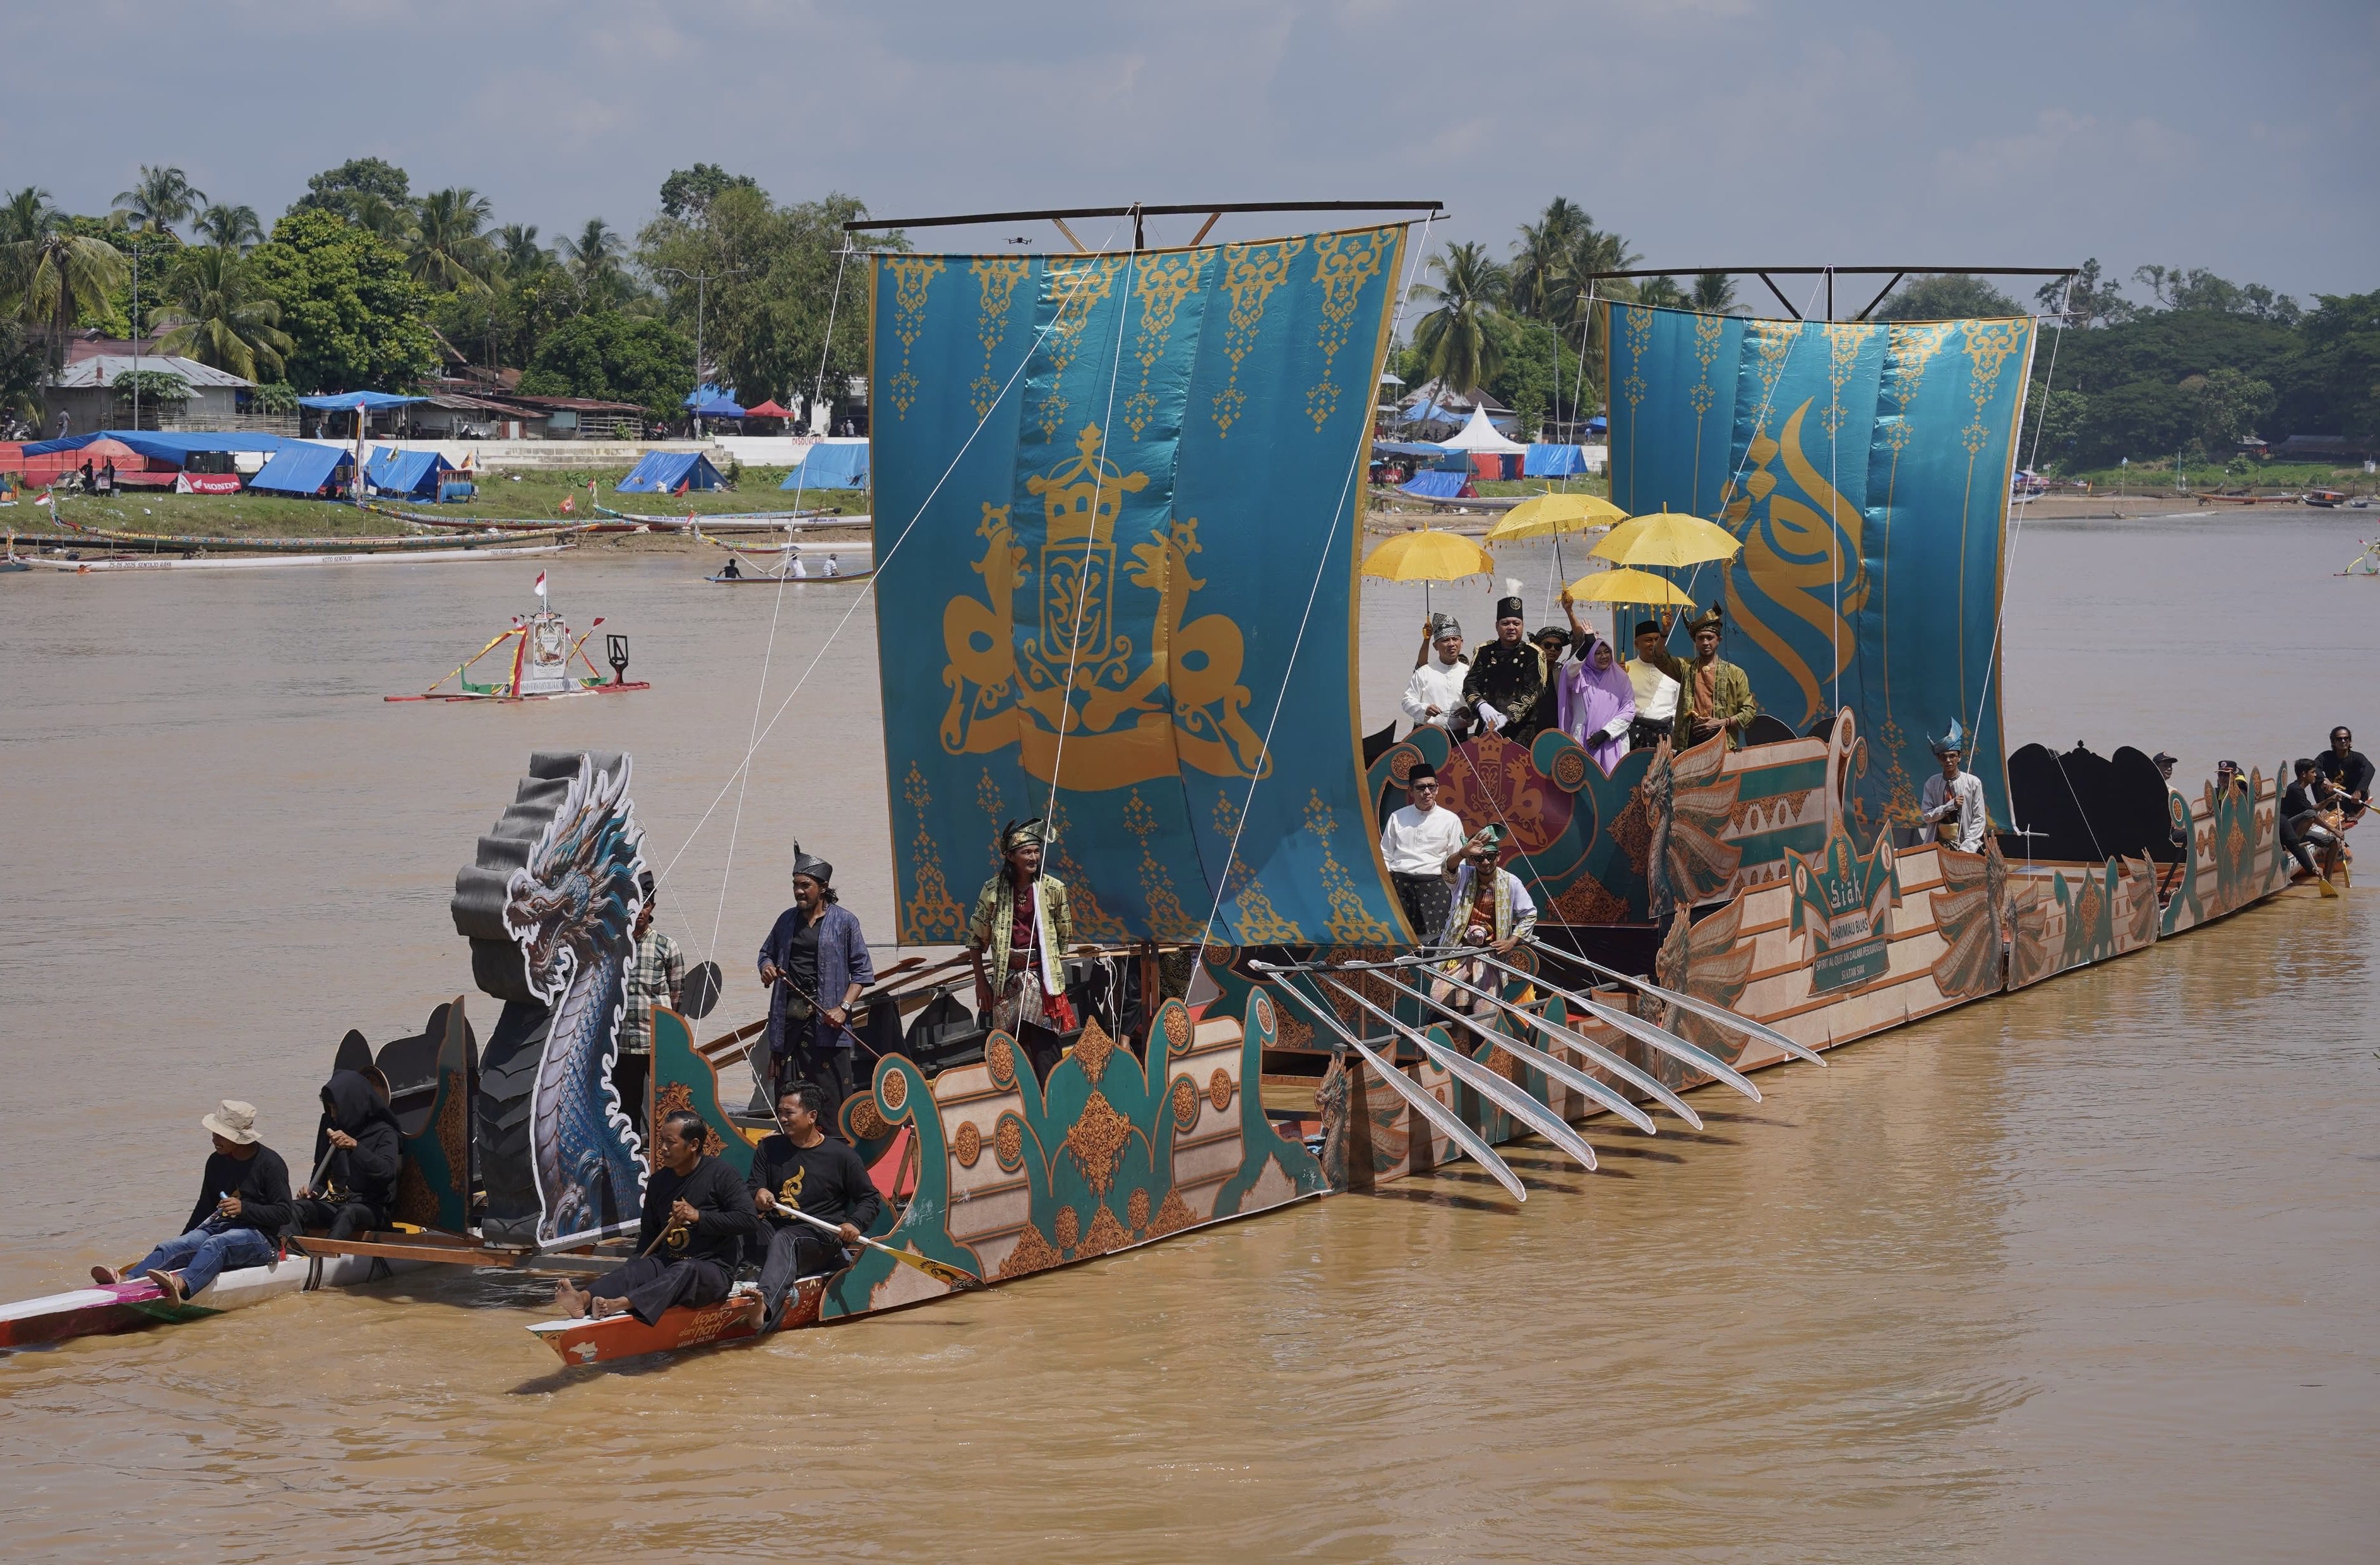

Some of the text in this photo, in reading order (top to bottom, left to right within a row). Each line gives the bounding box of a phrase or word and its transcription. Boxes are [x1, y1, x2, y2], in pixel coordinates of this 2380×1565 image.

[1884, 844, 1890, 867] 8
[1799, 871, 1804, 893] 8
[1831, 917, 1869, 941] HARIMAU BUAS
[1816, 958, 1829, 971] SPIRIT
[1850, 948, 1863, 961] DALAM
[1841, 964, 1865, 980] SULTAN SIAK
[679, 1319, 726, 1338] dari hati
[691, 1311, 721, 1326] kopi
